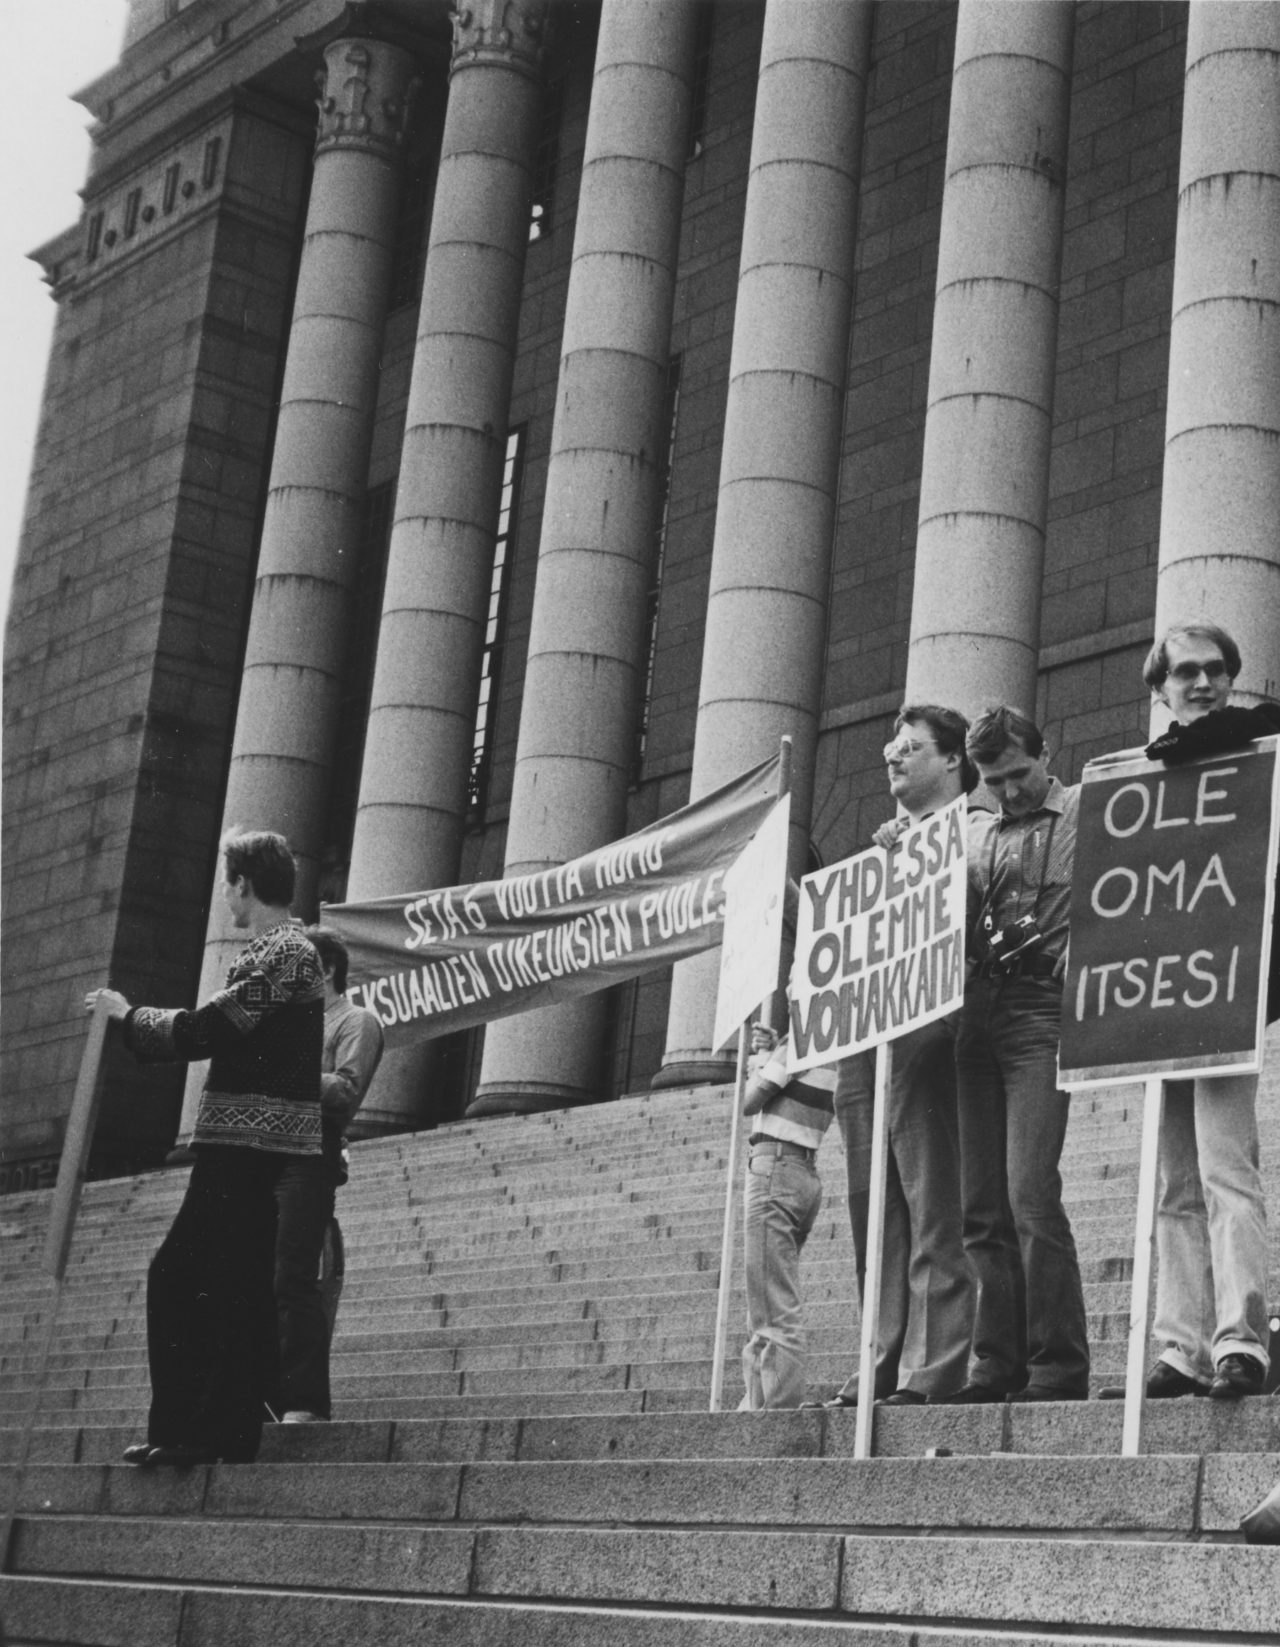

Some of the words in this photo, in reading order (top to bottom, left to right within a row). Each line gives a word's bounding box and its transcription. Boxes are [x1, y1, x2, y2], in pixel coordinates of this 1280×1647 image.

[1104, 767, 1239, 838] OLE
[804, 802, 964, 932] YHDESSÄ
[1091, 853, 1237, 918] OMA
[404, 890, 469, 949] SETA
[463, 883, 487, 930] 6
[808, 873, 952, 988] OLEMME
[345, 950, 490, 1028] EKSUAALIEN
[487, 901, 632, 992] OIKEUKSIEN
[790, 928, 963, 1060] VOIMAKKAITA
[1075, 945, 1240, 1022] ITSESI
